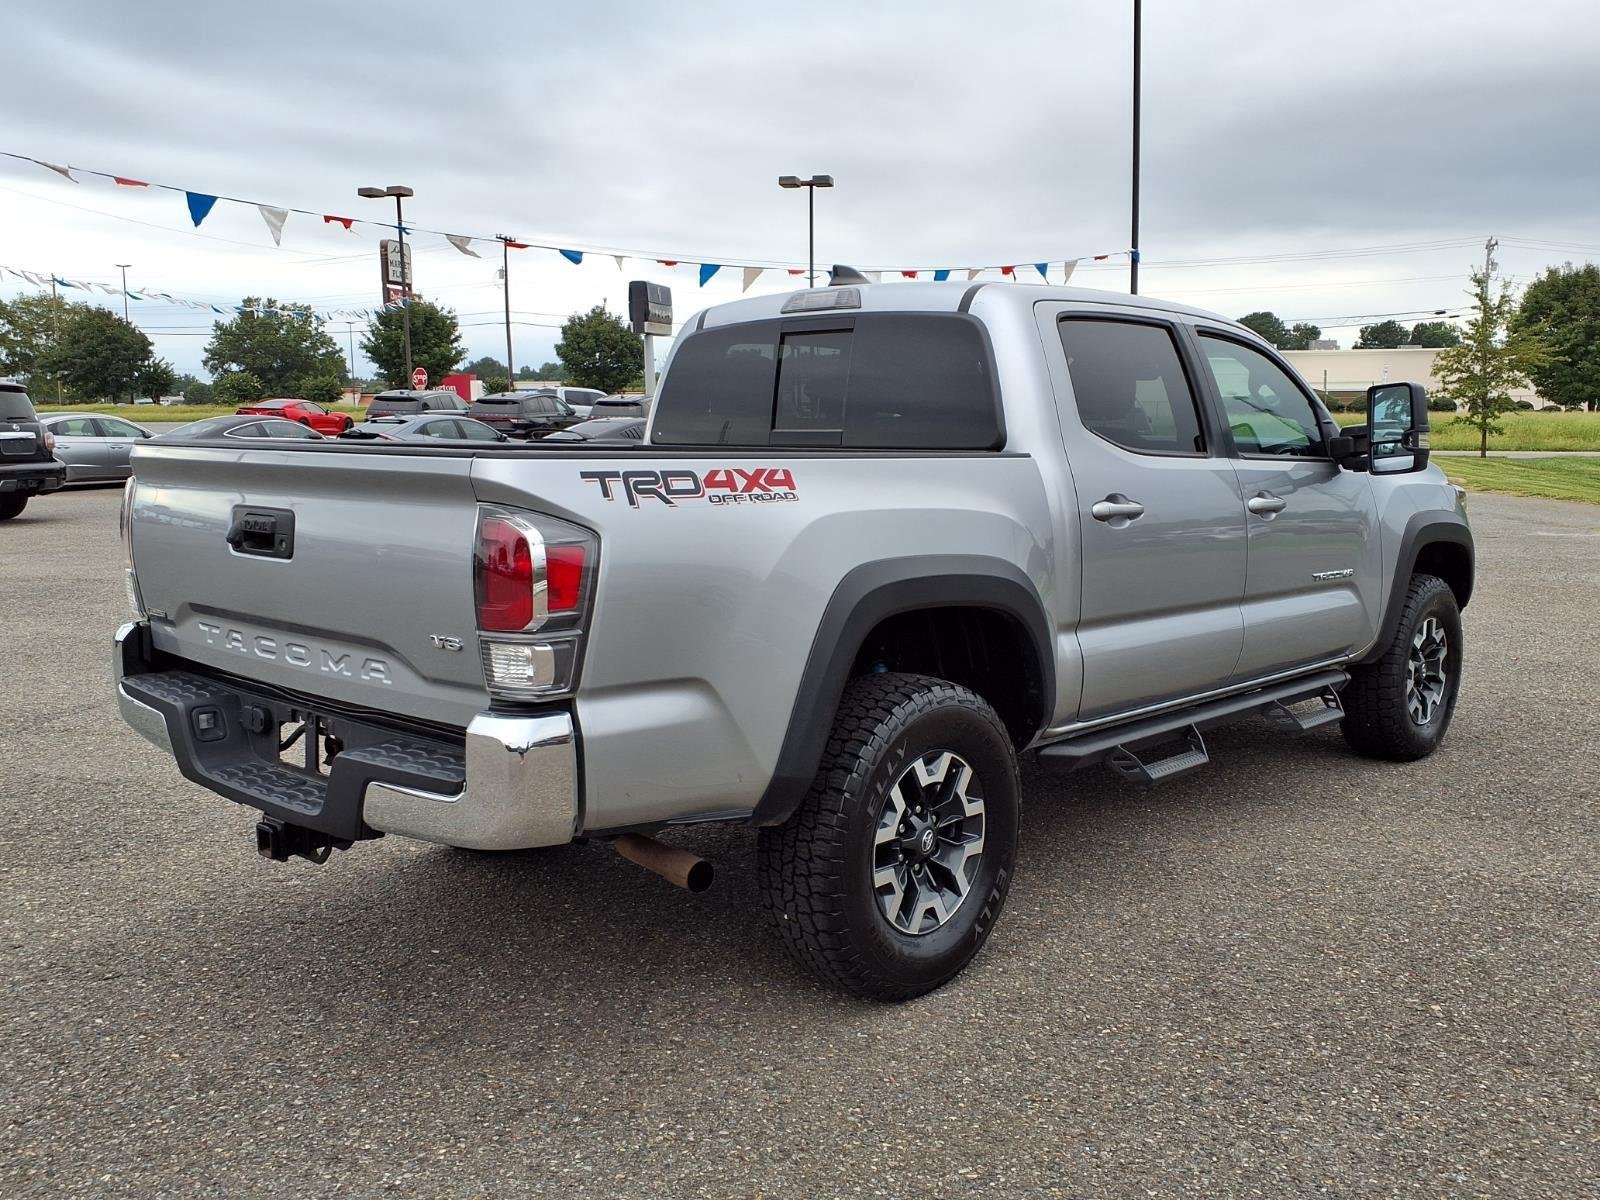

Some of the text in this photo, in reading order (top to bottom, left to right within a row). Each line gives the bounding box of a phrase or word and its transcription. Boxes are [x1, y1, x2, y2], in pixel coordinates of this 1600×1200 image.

[390, 259, 410, 270] MARET
[392, 269, 409, 279] PLAE
[413, 374, 426, 383] STOP
[579, 470, 706, 509] TRD
[708, 491, 798, 506] OFF ROAD
[198, 621, 393, 685] TACOMA
[865, 737, 908, 824] ELLY
[974, 862, 1008, 941] ELLY
